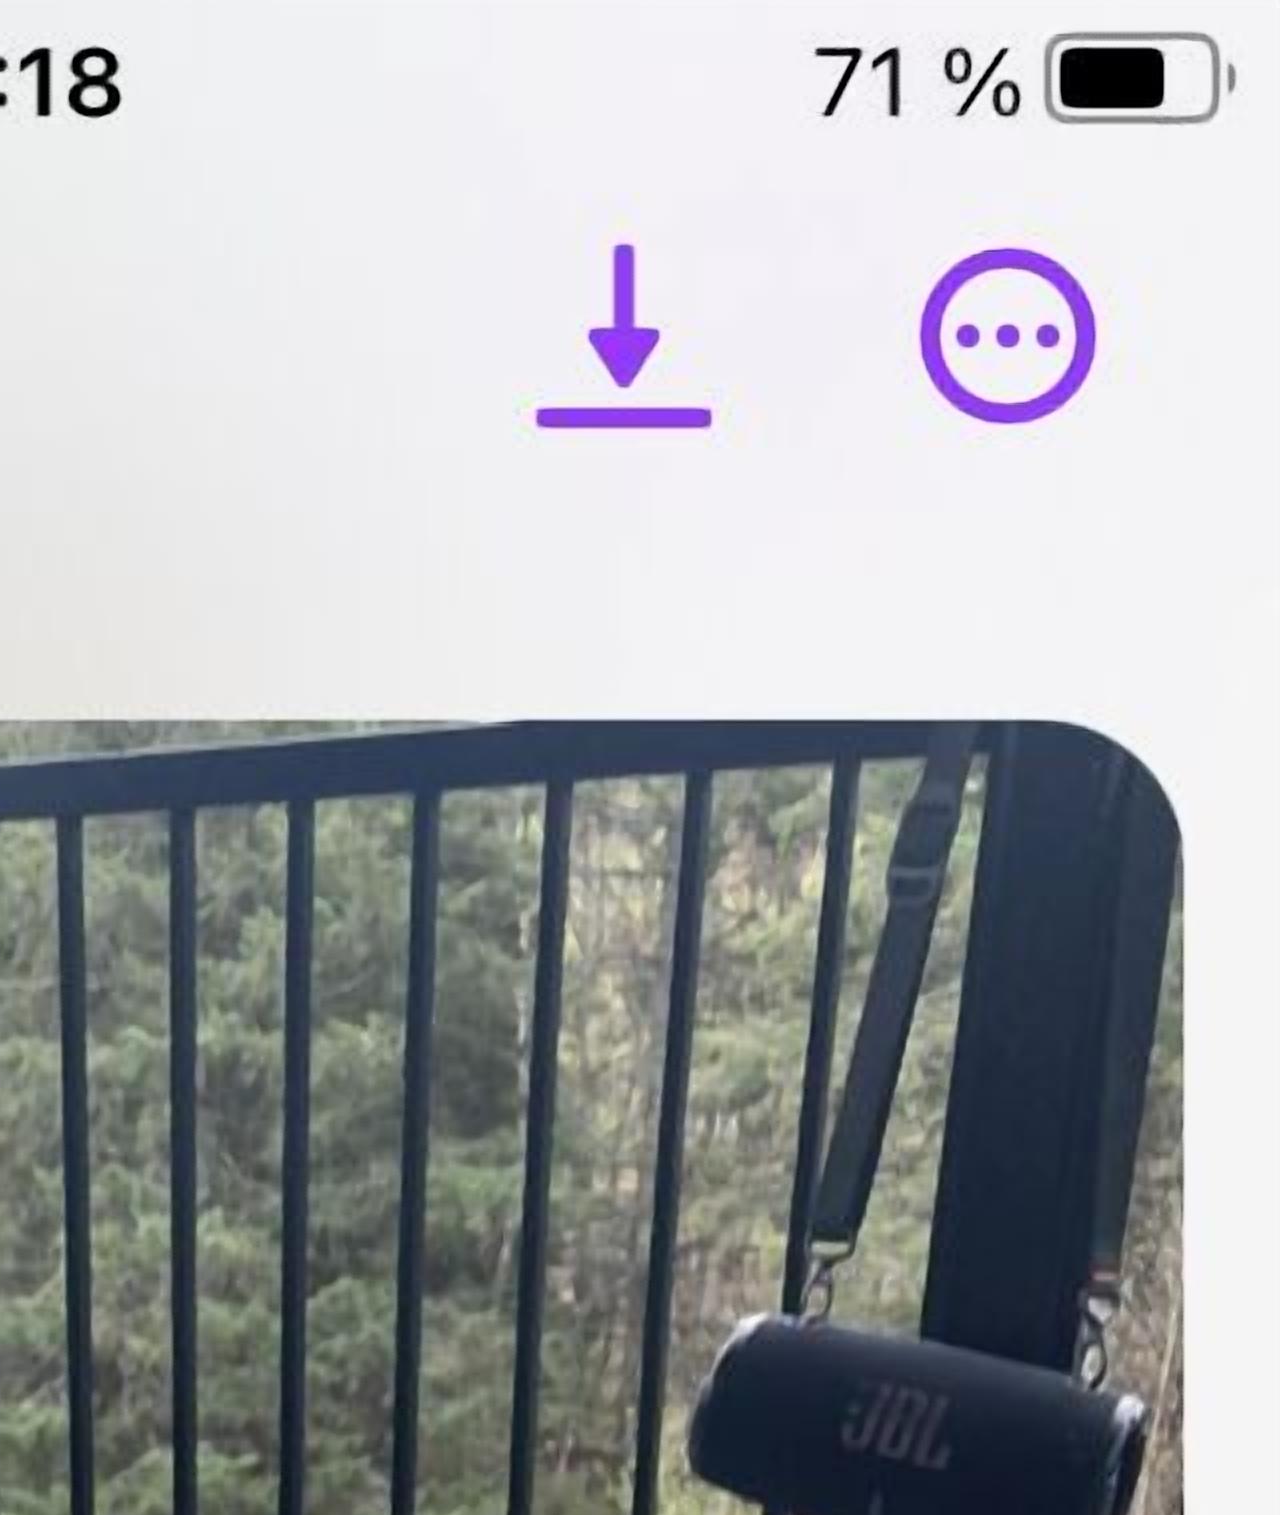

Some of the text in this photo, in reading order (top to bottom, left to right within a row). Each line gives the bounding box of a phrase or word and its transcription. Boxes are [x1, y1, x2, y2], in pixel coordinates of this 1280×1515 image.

[814, 47, 1022, 117] 71 %
[839, 1381, 952, 1472] JBL
